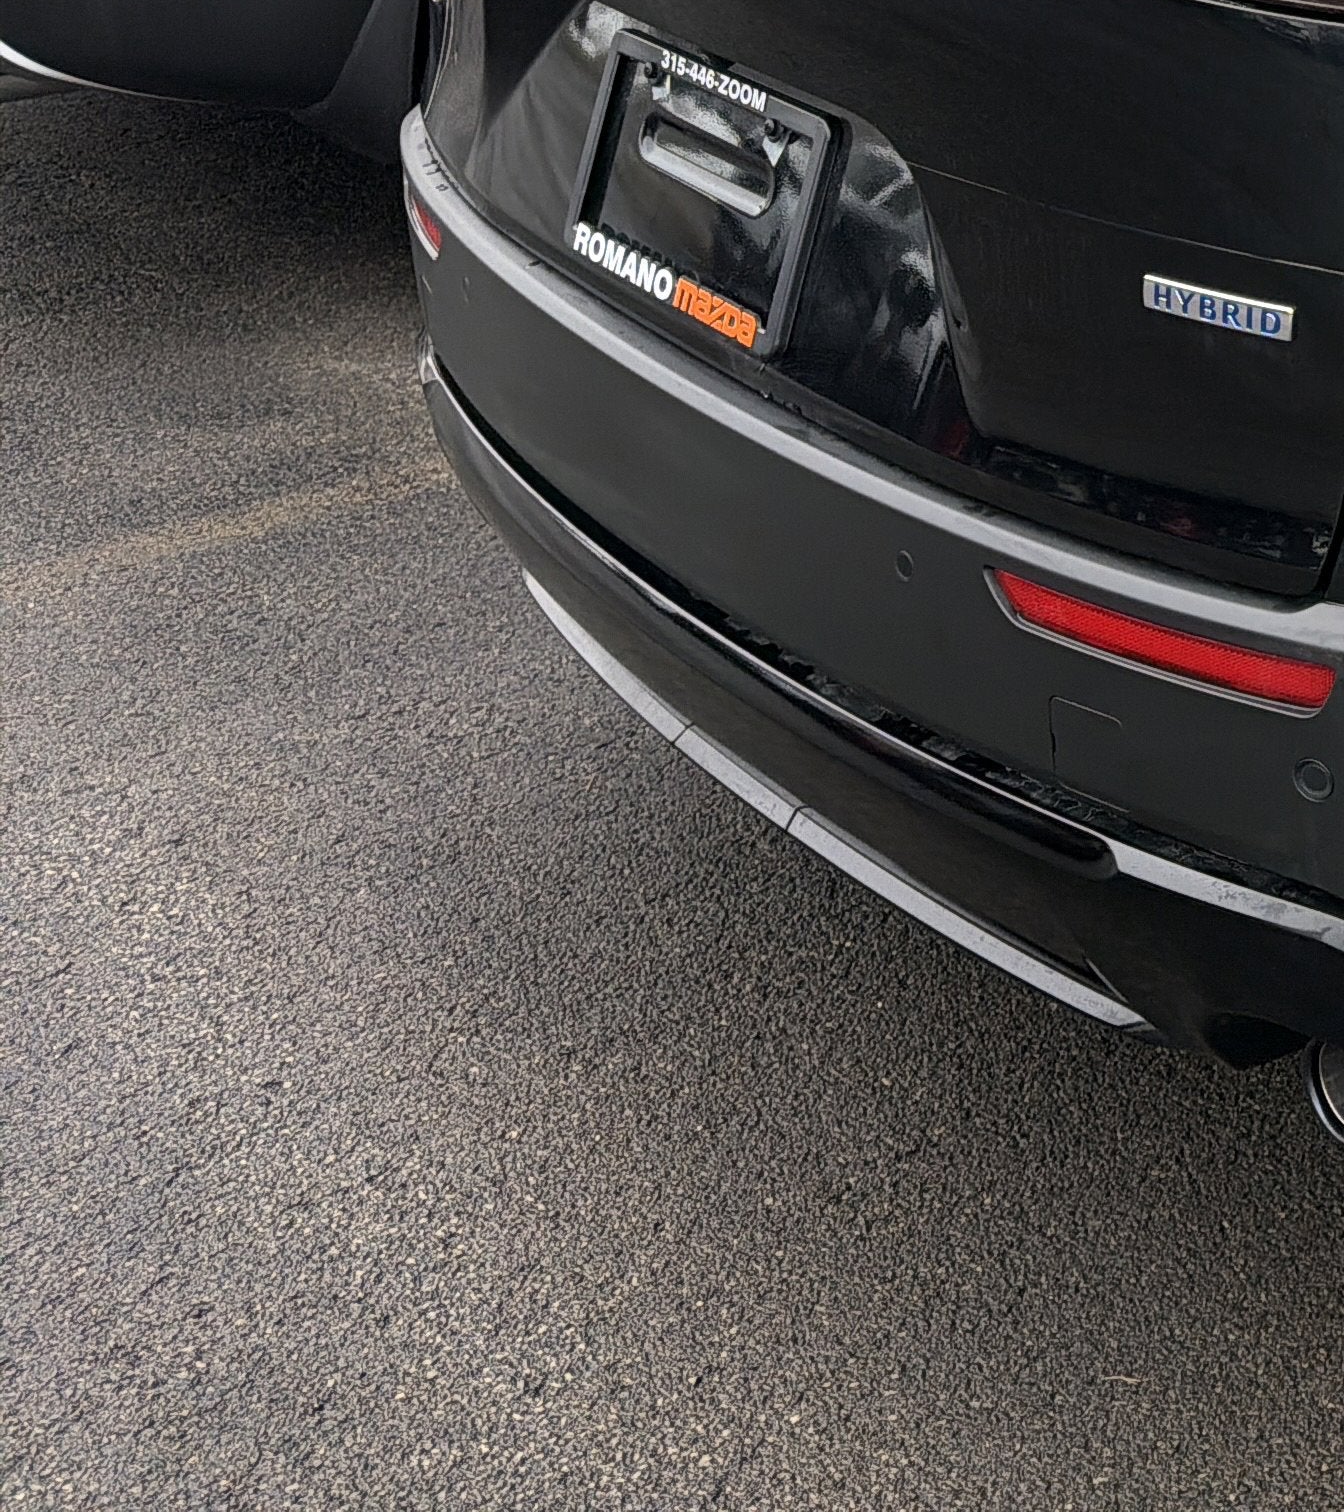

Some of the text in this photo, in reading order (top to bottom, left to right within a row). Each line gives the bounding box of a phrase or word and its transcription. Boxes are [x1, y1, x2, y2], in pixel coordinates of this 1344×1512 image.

[661, 49, 767, 112] 315-446-ZOOM
[573, 222, 673, 301] ROMANO
[1153, 284, 1281, 335] HYBRID
